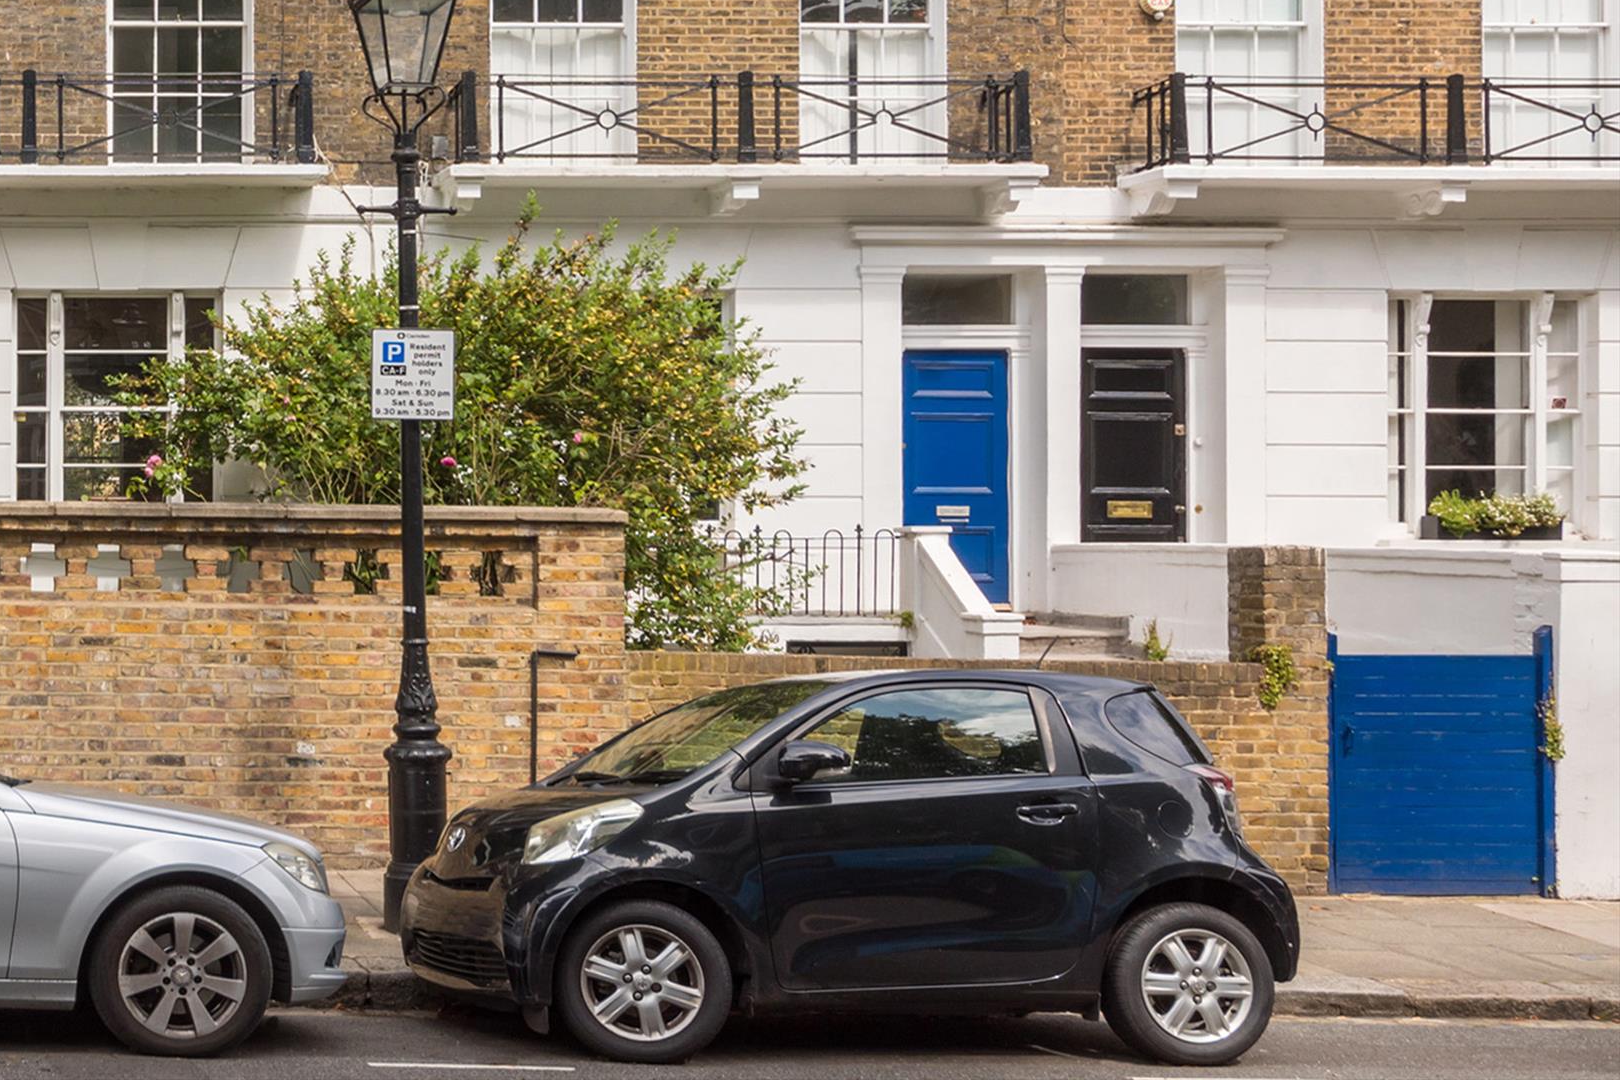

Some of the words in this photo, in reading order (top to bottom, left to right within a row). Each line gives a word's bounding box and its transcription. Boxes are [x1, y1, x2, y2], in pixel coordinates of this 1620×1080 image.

[410, 343, 446, 351] Resident
[388, 344, 402, 361] P
[413, 352, 441, 360] permit
[418, 368, 436, 376] only
[395, 379, 413, 387] Mon
[419, 379, 431, 387] Fri
[416, 388, 436, 397] 6.30
[437, 390, 450, 398] pm
[391, 399, 406, 407] Sat
[417, 399, 434, 407] Sun
